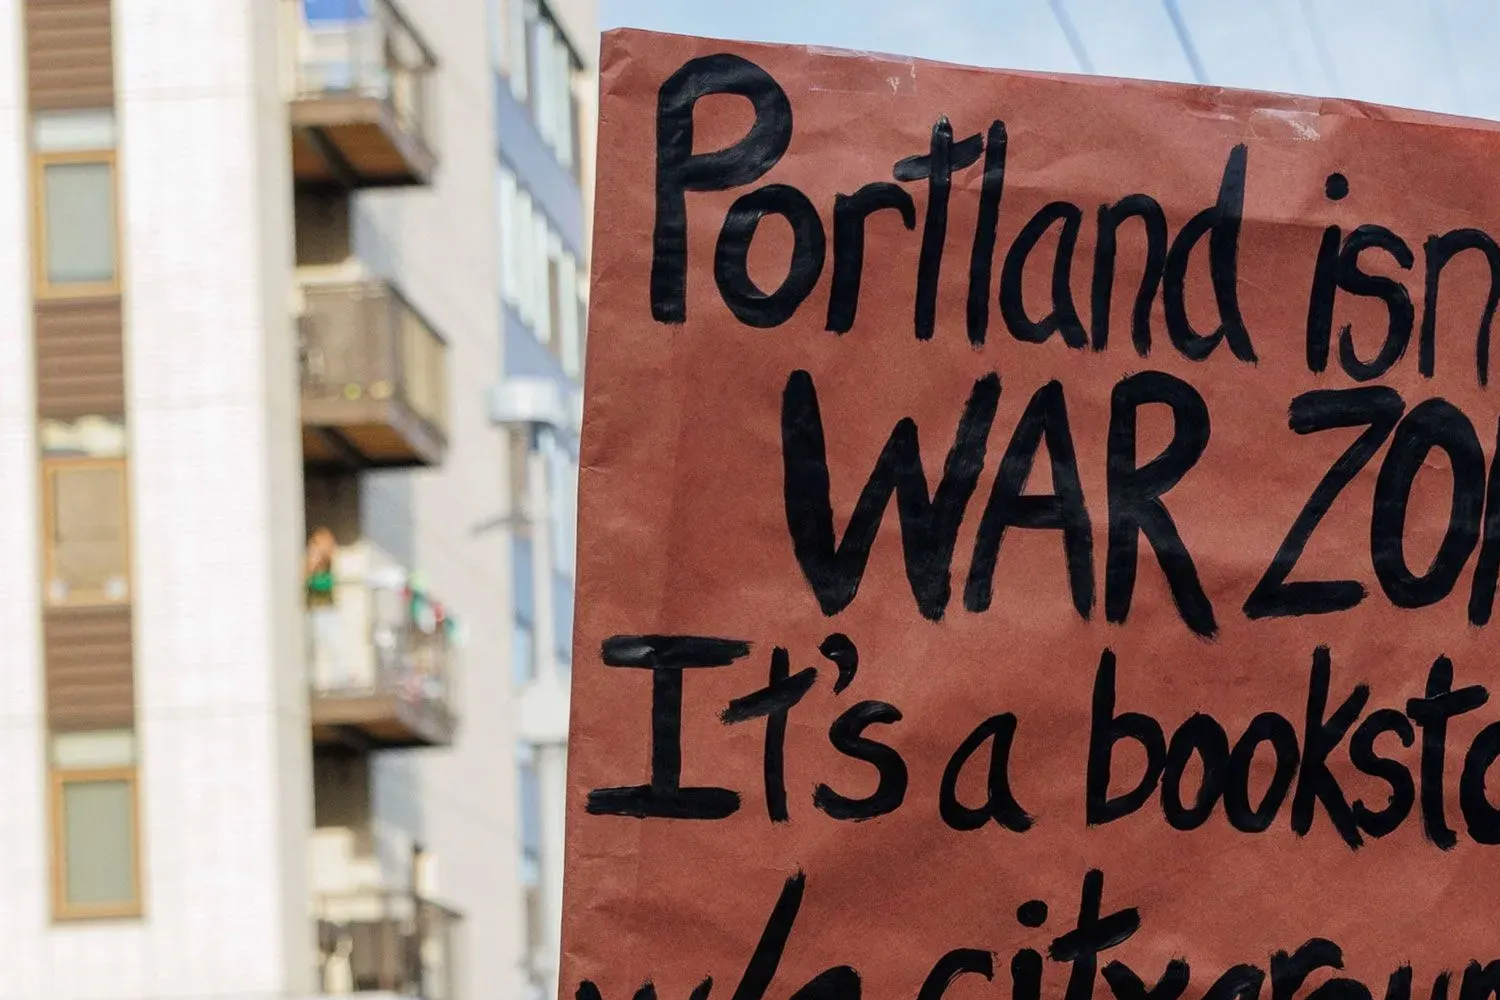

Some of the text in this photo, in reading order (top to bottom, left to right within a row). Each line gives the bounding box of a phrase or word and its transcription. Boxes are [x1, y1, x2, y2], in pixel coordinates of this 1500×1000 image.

[649, 53, 1259, 366] Portland
[780, 368, 1220, 642] WAR
[584, 631, 909, 824] It's
[938, 710, 1036, 833] a
